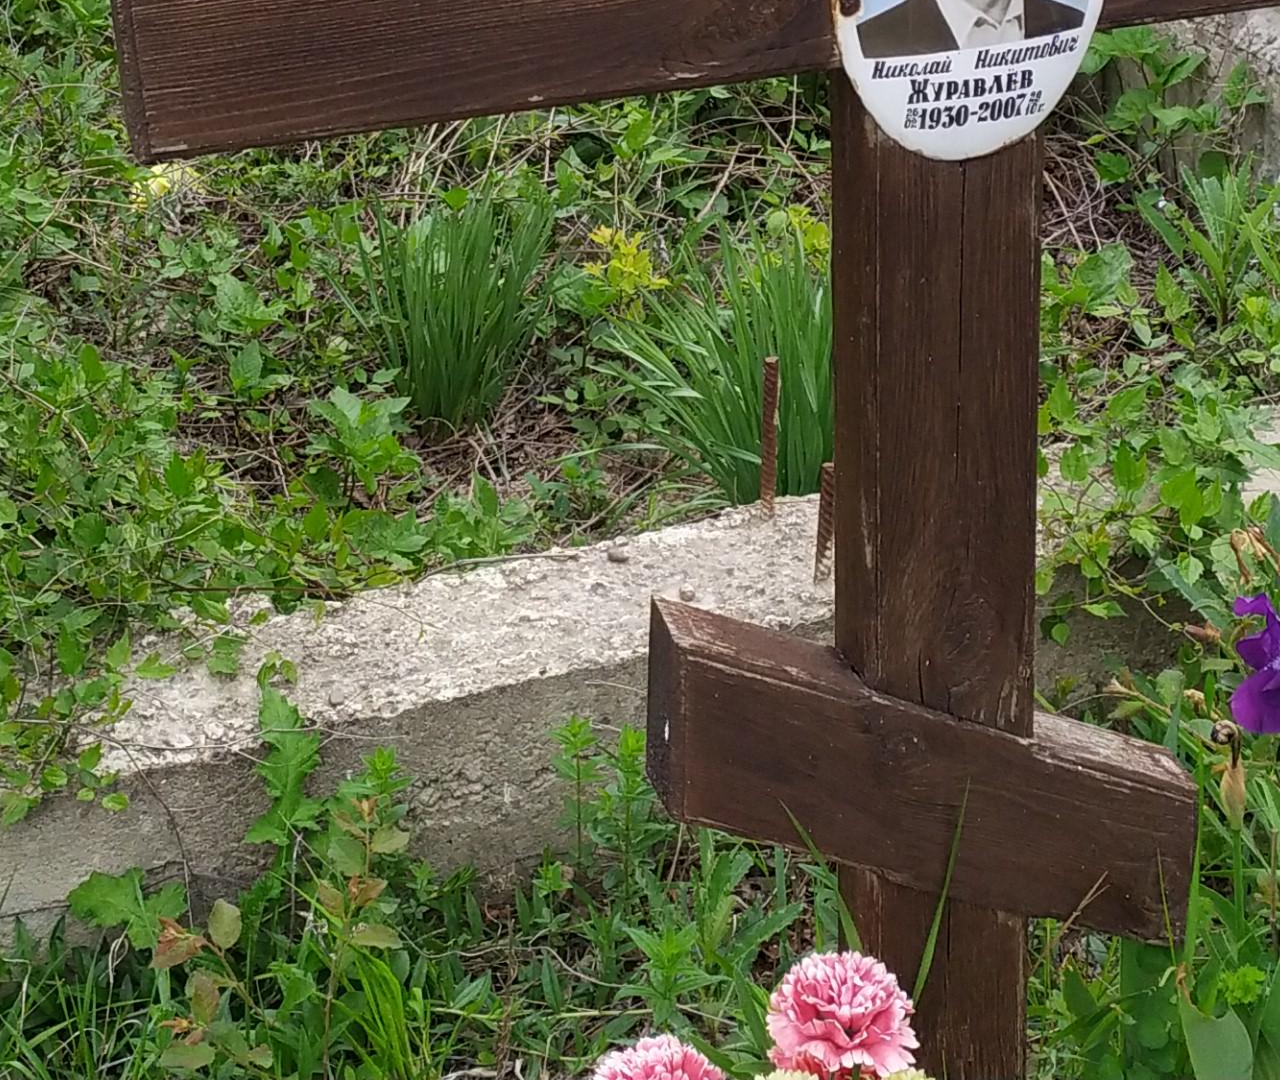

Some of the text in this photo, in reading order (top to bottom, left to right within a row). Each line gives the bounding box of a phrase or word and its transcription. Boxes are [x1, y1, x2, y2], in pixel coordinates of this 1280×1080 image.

[871, 34, 1080, 80] Николай Никитович
[907, 68, 1034, 105] ЖУРАВЛЁВ
